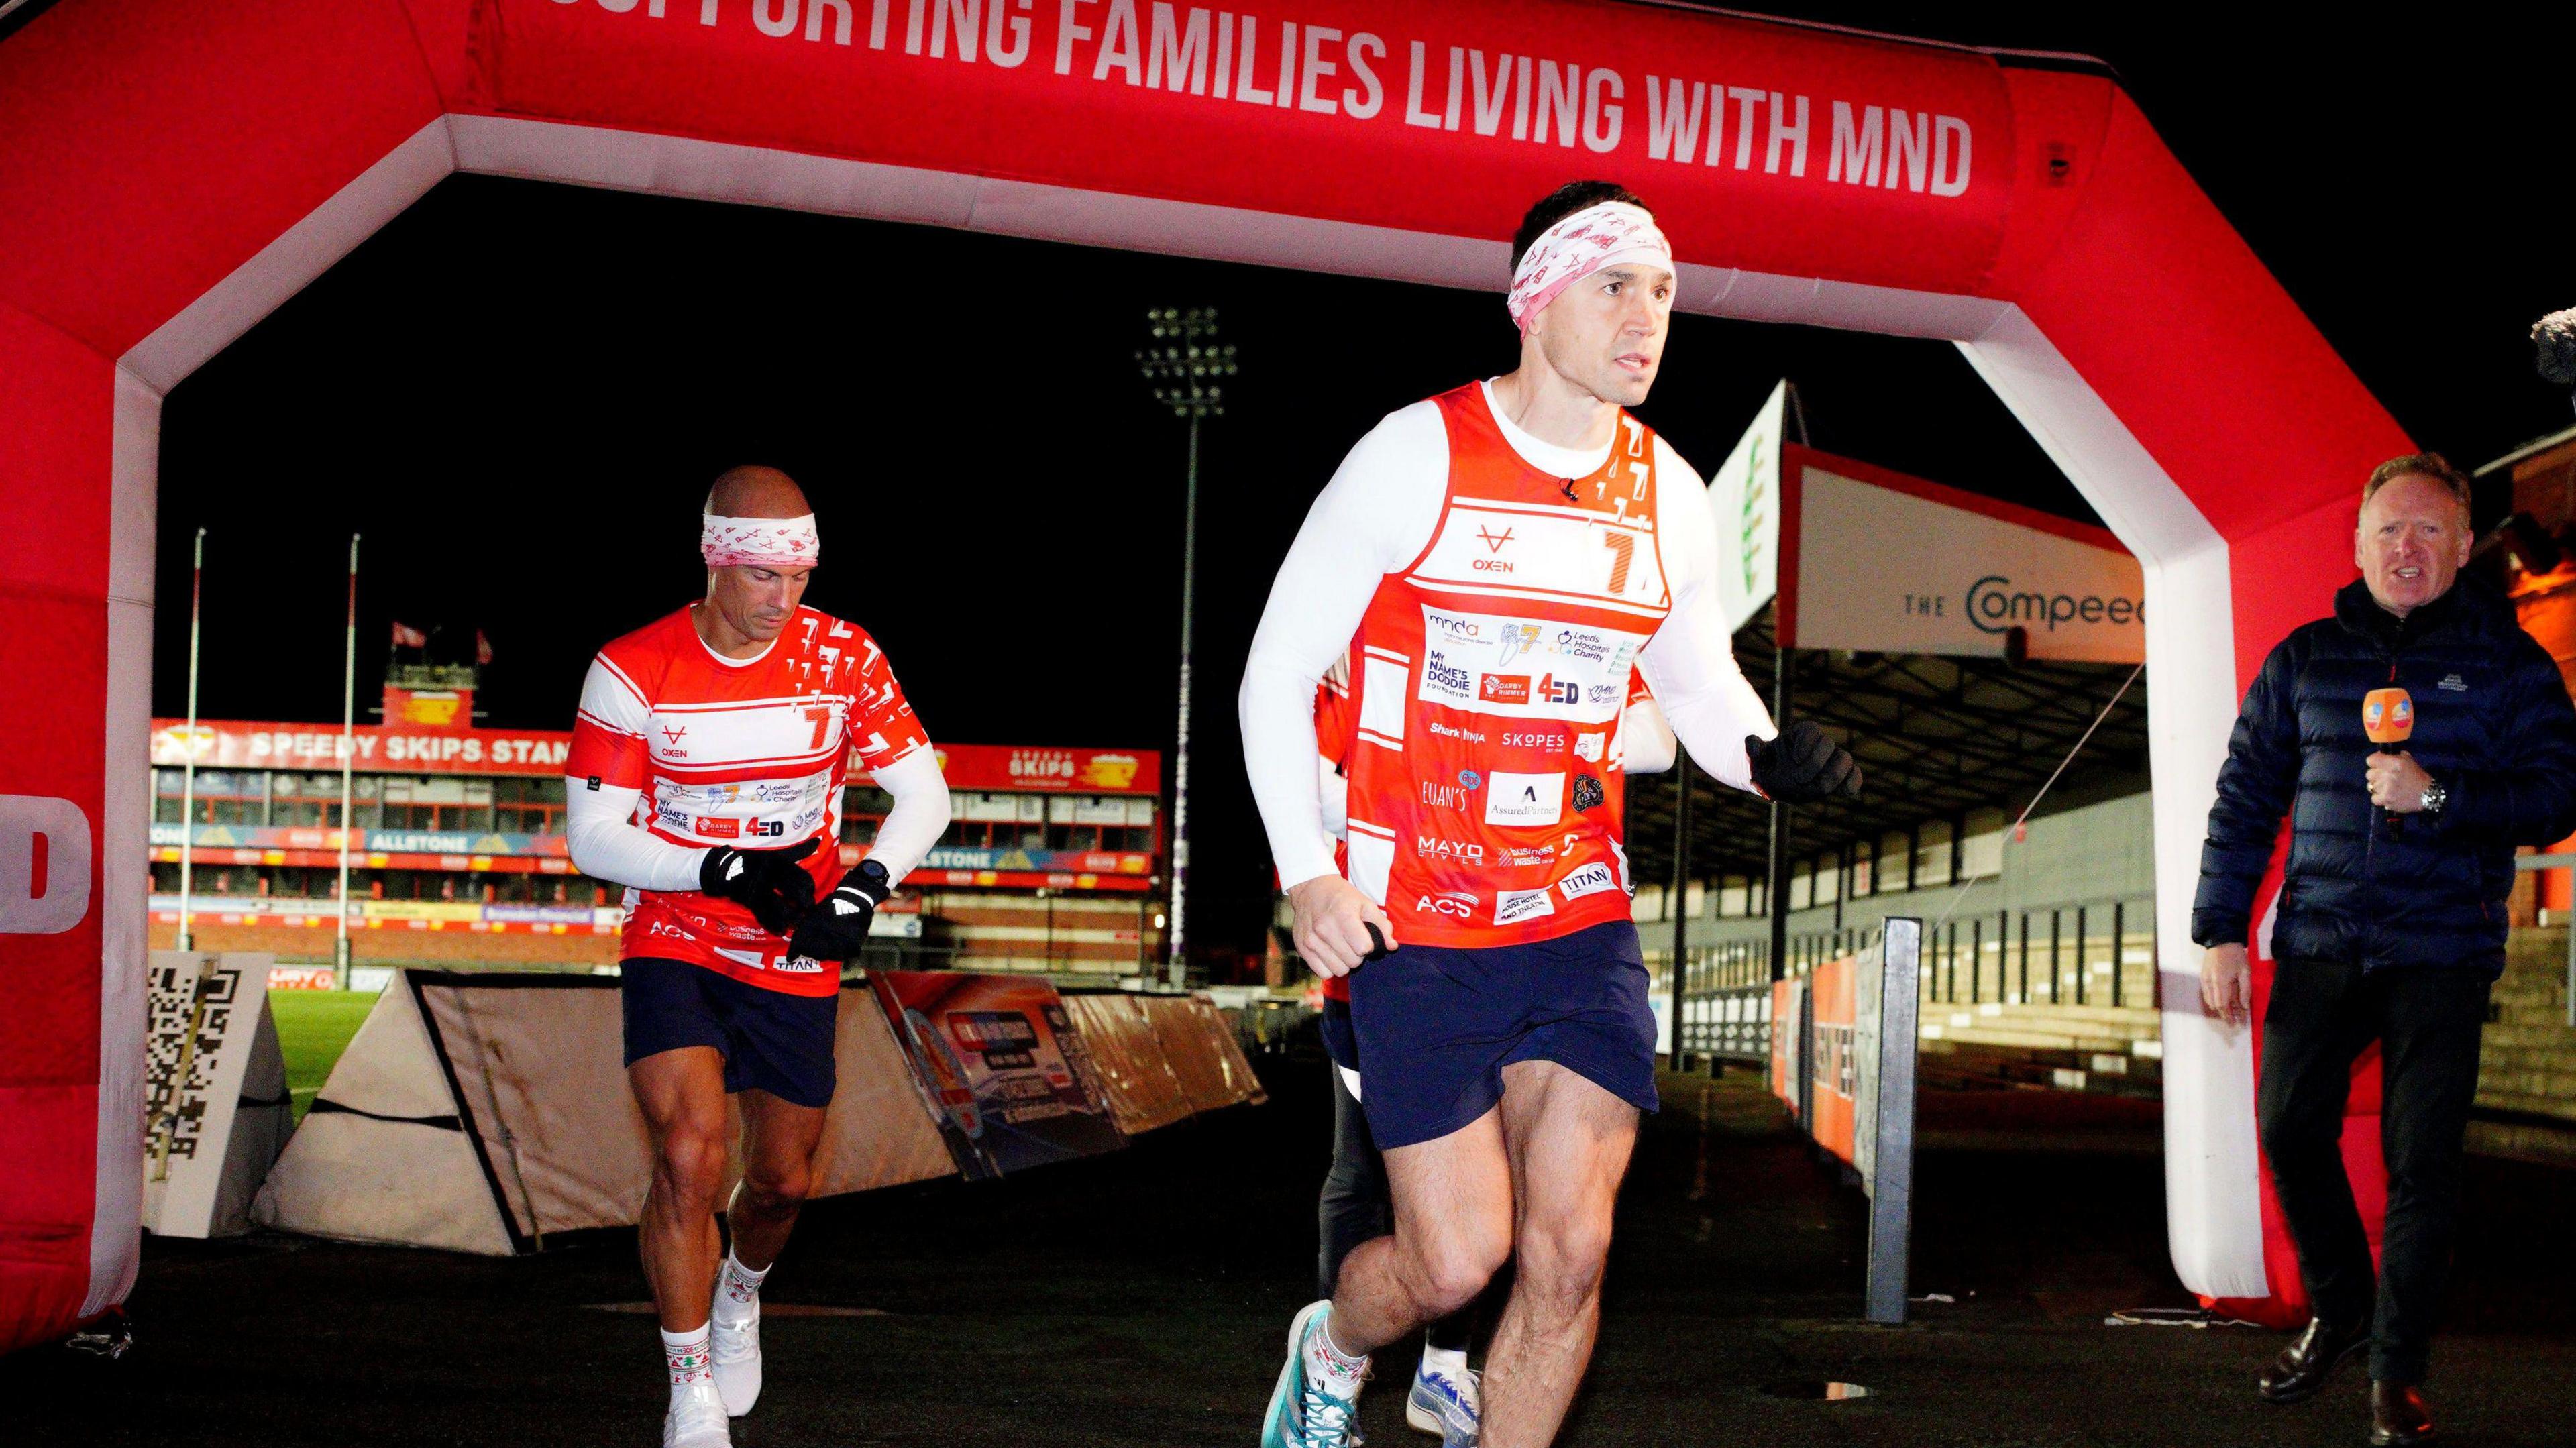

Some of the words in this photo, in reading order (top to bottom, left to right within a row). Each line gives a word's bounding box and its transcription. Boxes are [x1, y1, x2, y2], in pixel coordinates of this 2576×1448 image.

[1055, 0, 1386, 119] FAMILIES
[1405, 39, 1625, 153] LIVING
[1646, 74, 1809, 177] WITH
[1827, 100, 1971, 197] MND
[1472, 559, 1513, 573] OXEN
[1604, 529, 1635, 596] 7
[1904, 594, 1945, 616] THE
[1574, 632, 1599, 643] Leeds
[1574, 642, 1611, 653] Hospitals
[1431, 650, 1444, 663] MY
[1574, 649, 1603, 662] Charity
[1428, 671, 1470, 691] DODDIE
[1427, 683, 1469, 698] FOUNDATION
[804, 708, 830, 750] 7
[1430, 722, 1460, 738] Shark
[1502, 732, 1564, 746] SKOPES
[251, 732, 376, 759] SPEEDY
[386, 736, 483, 763] SKIPS
[663, 748, 687, 757] OXEN
[659, 799, 672, 807] MY
[1423, 781, 1466, 811] EUAN'S
[657, 805, 688, 820] NAME'S
[1418, 836, 1483, 858] MAYO
[1510, 845, 1554, 856] business
[1418, 850, 1482, 866] CIVILS
[1562, 869, 1608, 890] TITAN
[1416, 895, 1471, 917] ACS
[1521, 894, 1540, 905] HOTEL
[776, 960, 814, 970] TITAN
